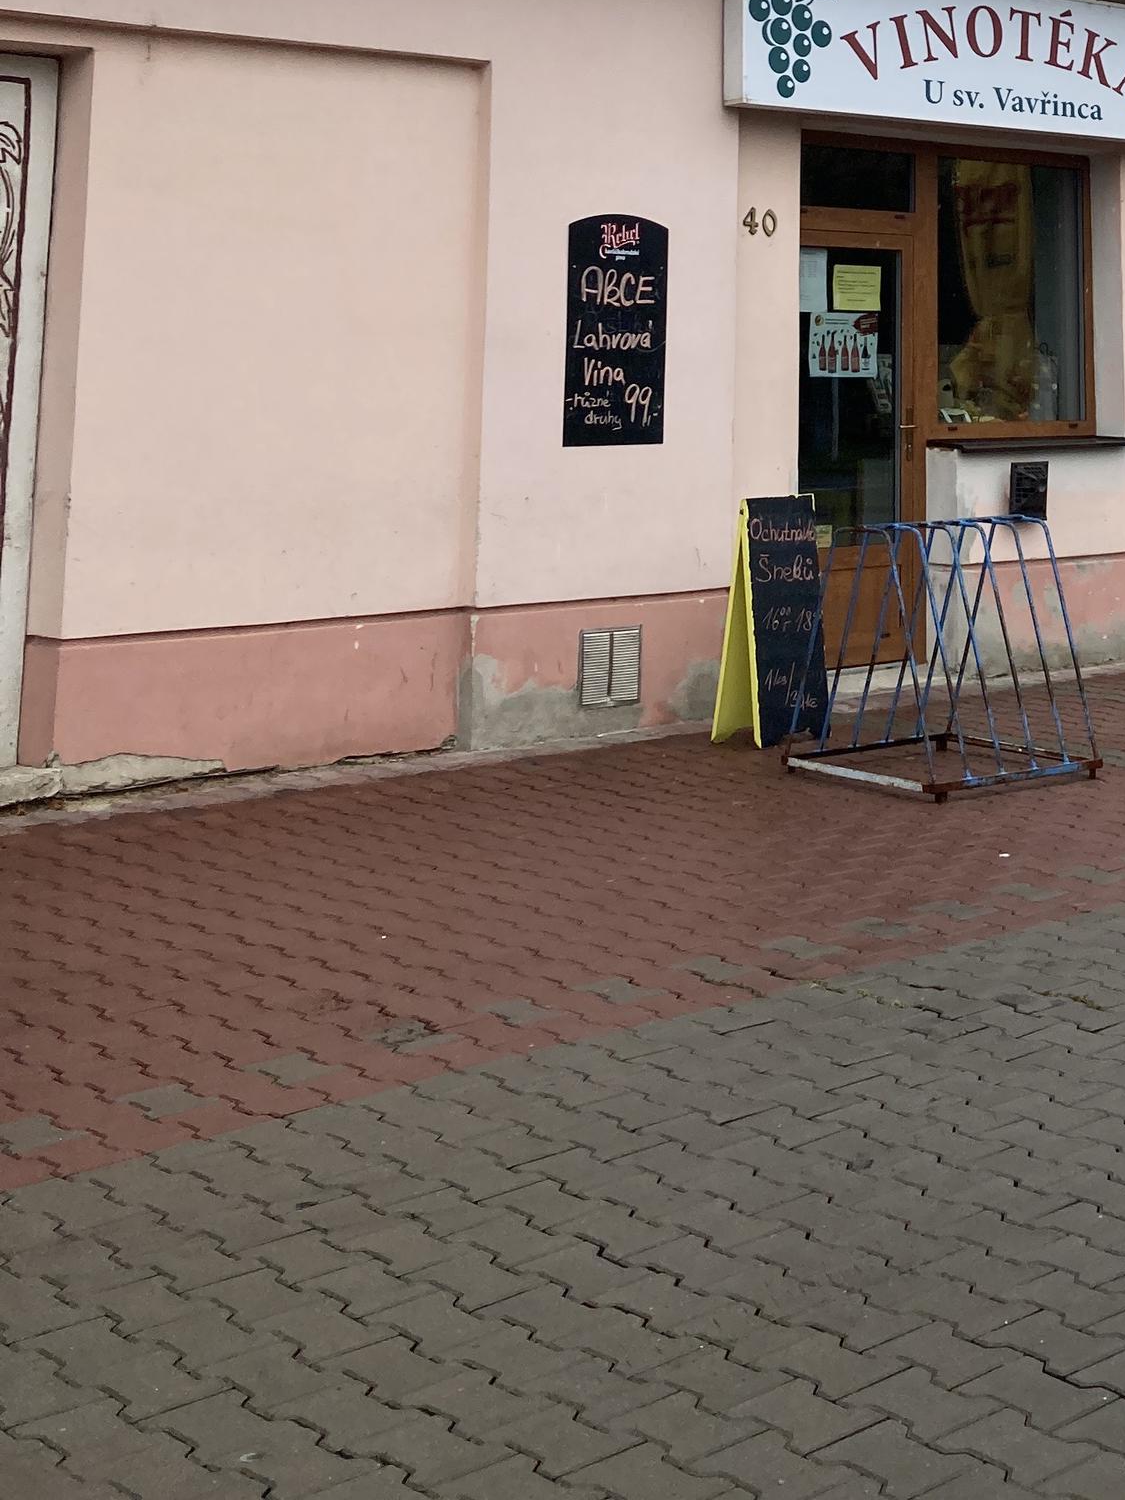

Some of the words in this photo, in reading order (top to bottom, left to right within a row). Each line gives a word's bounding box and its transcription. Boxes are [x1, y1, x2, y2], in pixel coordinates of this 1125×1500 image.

[923, 78, 945, 104] U
[953, 88, 985, 109] sv.
[993, 86, 1104, 121] Vavřinca
[742, 206, 778, 237] 40
[580, 265, 656, 307] AKCE
[573, 319, 653, 351] Lahvová
[584, 410, 622, 431] druhy
